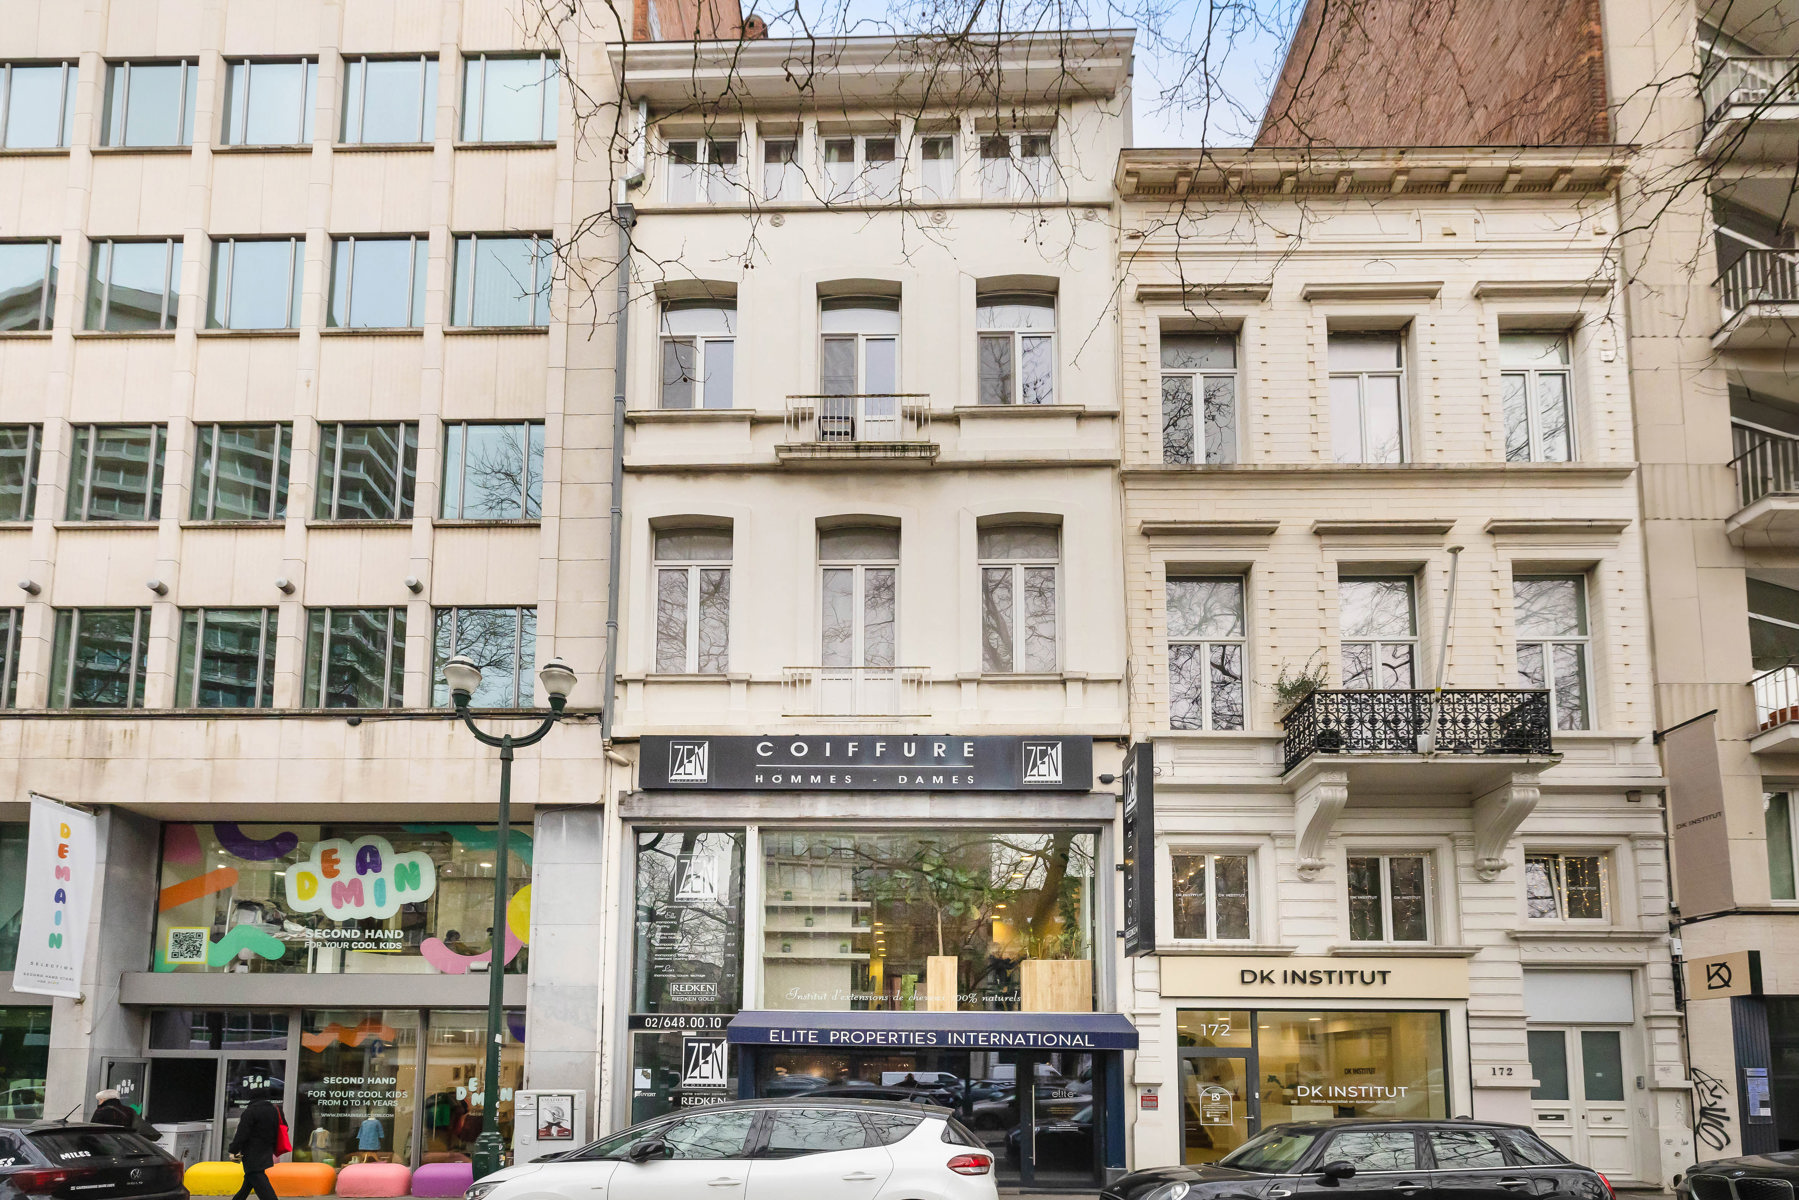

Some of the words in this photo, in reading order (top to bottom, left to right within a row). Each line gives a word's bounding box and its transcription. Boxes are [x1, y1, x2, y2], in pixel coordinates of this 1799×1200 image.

[756, 741, 974, 757] COIFFURE
[673, 745, 704, 776] ZEN
[1026, 746, 1058, 777] ZEN
[755, 774, 852, 784] HOMMES
[898, 775, 974, 784] DAMES
[1689, 811, 1722, 826] INSTITUT
[296, 844, 421, 909] DEMAIN
[48, 822, 71, 949] DEMAIN
[305, 929, 360, 939] SECOND
[365, 929, 404, 939] HAND
[304, 941, 321, 949] FOR
[324, 941, 349, 949] YOUR
[351, 941, 377, 949] COOL
[379, 941, 402, 949] KIDS
[1241, 969, 1275, 984] DK
[1284, 970, 1391, 985] INSTITUT
[785, 986, 827, 1001] Institut
[832, 988, 889, 1001] d'extensions
[893, 988, 904, 1000] de
[981, 990, 1021, 1002] naturels
[645, 1016, 722, 1029] 02/648.00.10
[1200, 1023, 1231, 1036] 172
[769, 1029, 818, 1043] ELITE
[830, 1031, 937, 1044] PROPERTIES
[948, 1032, 1095, 1047] INTERNATIONAL
[687, 1042, 725, 1079] ZEN
[1344, 1067, 1352, 1075] DK
[1353, 1067, 1376, 1075] INSTITUT
[1491, 1067, 1513, 1076] 172
[323, 1076, 364, 1084] SECOND
[367, 1077, 396, 1085] HAND
[308, 1090, 326, 1098] FOR
[329, 1090, 354, 1098] YOUR
[386, 1091, 408, 1099] KIDS
[456, 1077, 513, 1107] DEMN
[1297, 1085, 1323, 1097] DK
[1329, 1086, 1408, 1098] INSTITUT
[681, 1097, 727, 1106] REDKEN
[60, 1150, 91, 1160] MILES
